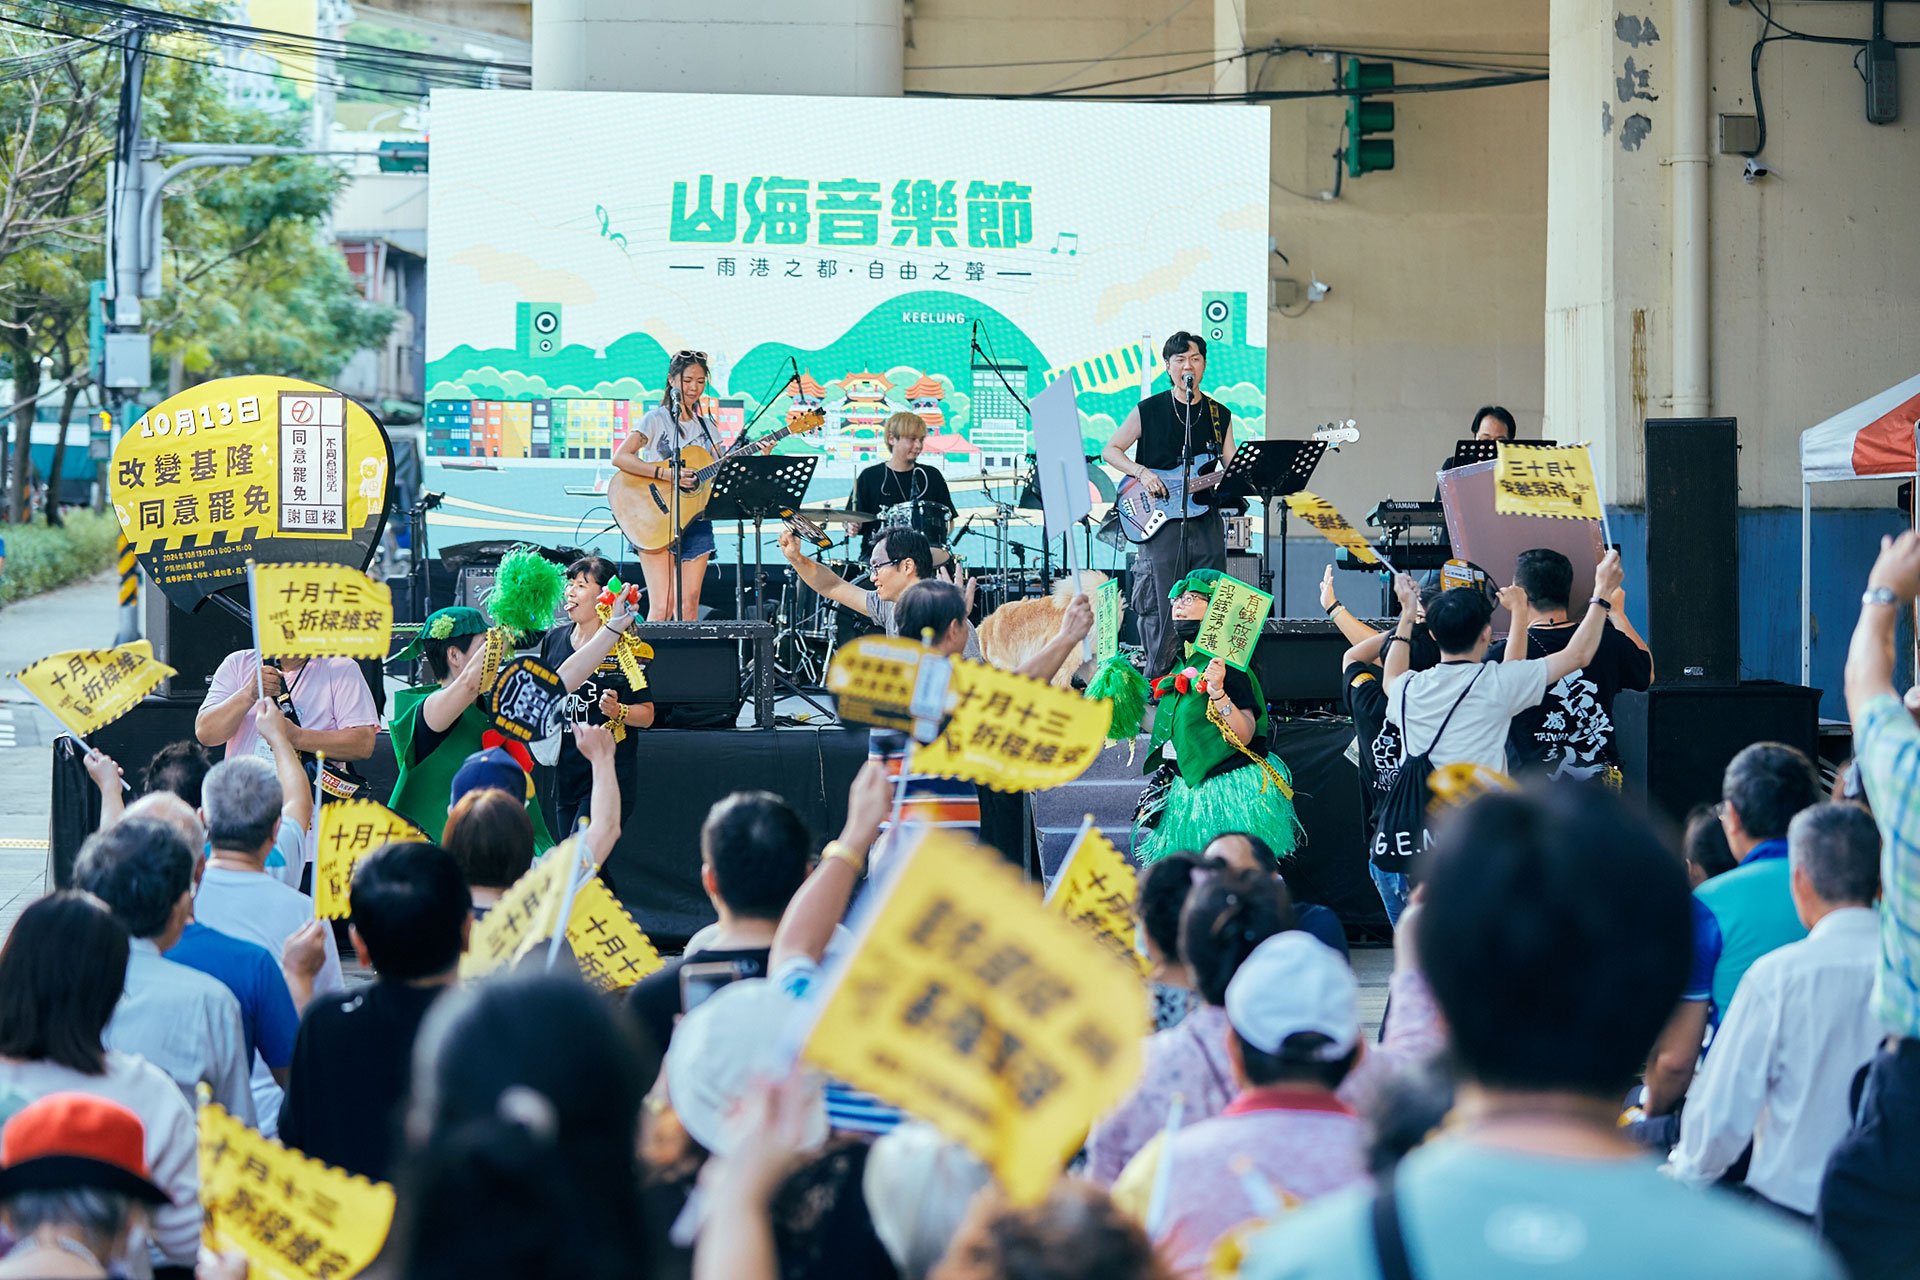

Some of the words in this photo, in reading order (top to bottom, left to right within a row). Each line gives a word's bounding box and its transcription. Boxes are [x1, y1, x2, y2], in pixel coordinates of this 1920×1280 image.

[668, 173, 1034, 250] 山海音樂節
[902, 311, 966, 324] KEELUNG
[139, 396, 261, 439] 10月13日
[118, 442, 254, 490] 改變基隆
[292, 428, 307, 502] 同意罷免
[139, 484, 271, 532] 同意罷免
[287, 507, 337, 525] 謝國樑
[1394, 502, 1421, 510] YAMAHA
[279, 580, 362, 604] 十月十三
[298, 608, 384, 632] 拆樑維安
[50, 648, 115, 690] 十月十
[961, 683, 1074, 737] 十月十三
